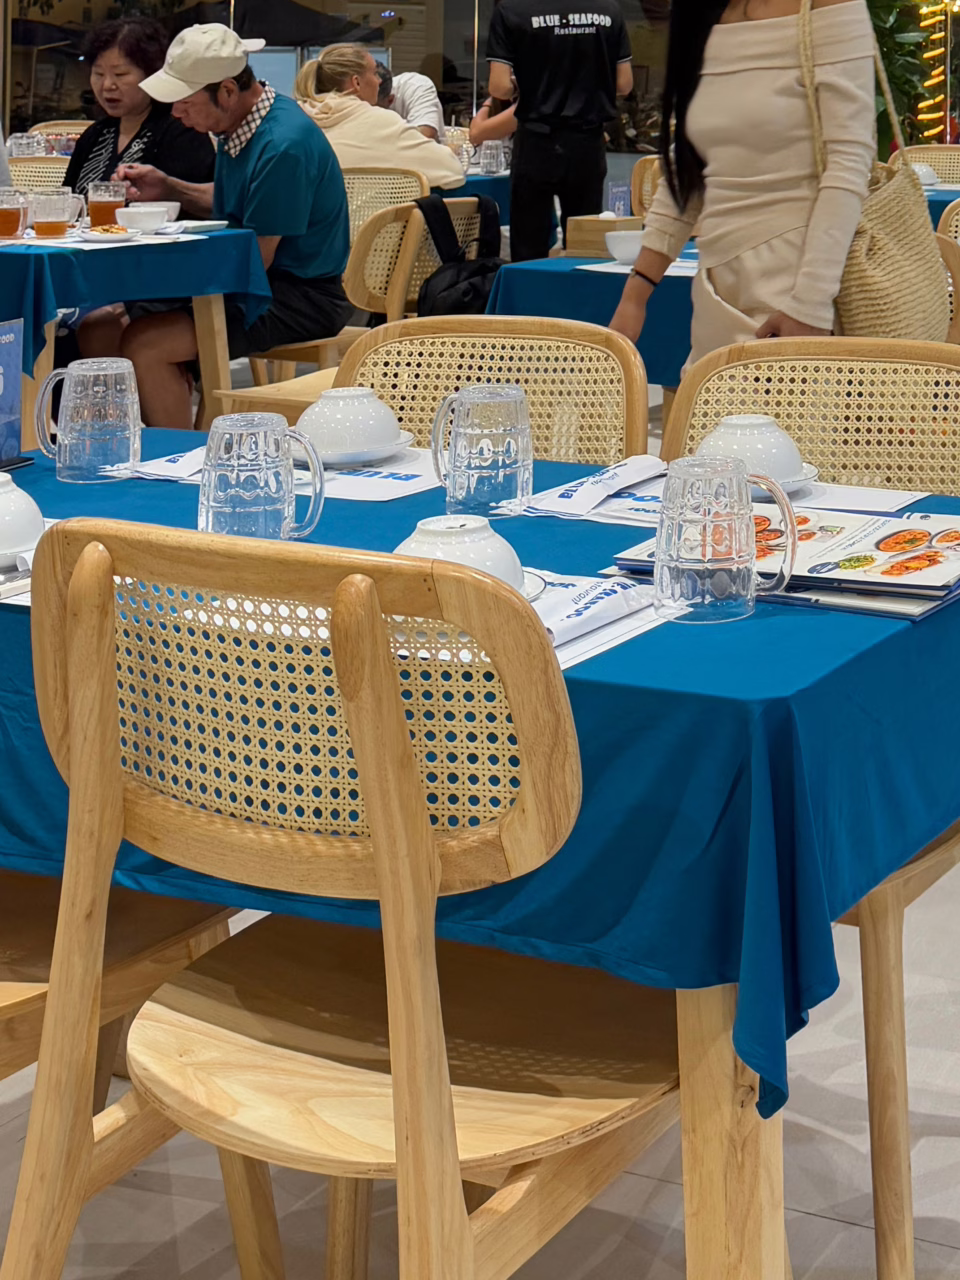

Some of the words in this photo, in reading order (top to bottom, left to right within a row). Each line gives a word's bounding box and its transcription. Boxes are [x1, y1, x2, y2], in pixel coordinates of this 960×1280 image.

[531, 14, 560, 28] BLUE
[568, 12, 612, 27] SEAFOOD
[554, 26, 597, 35] Restaurant
